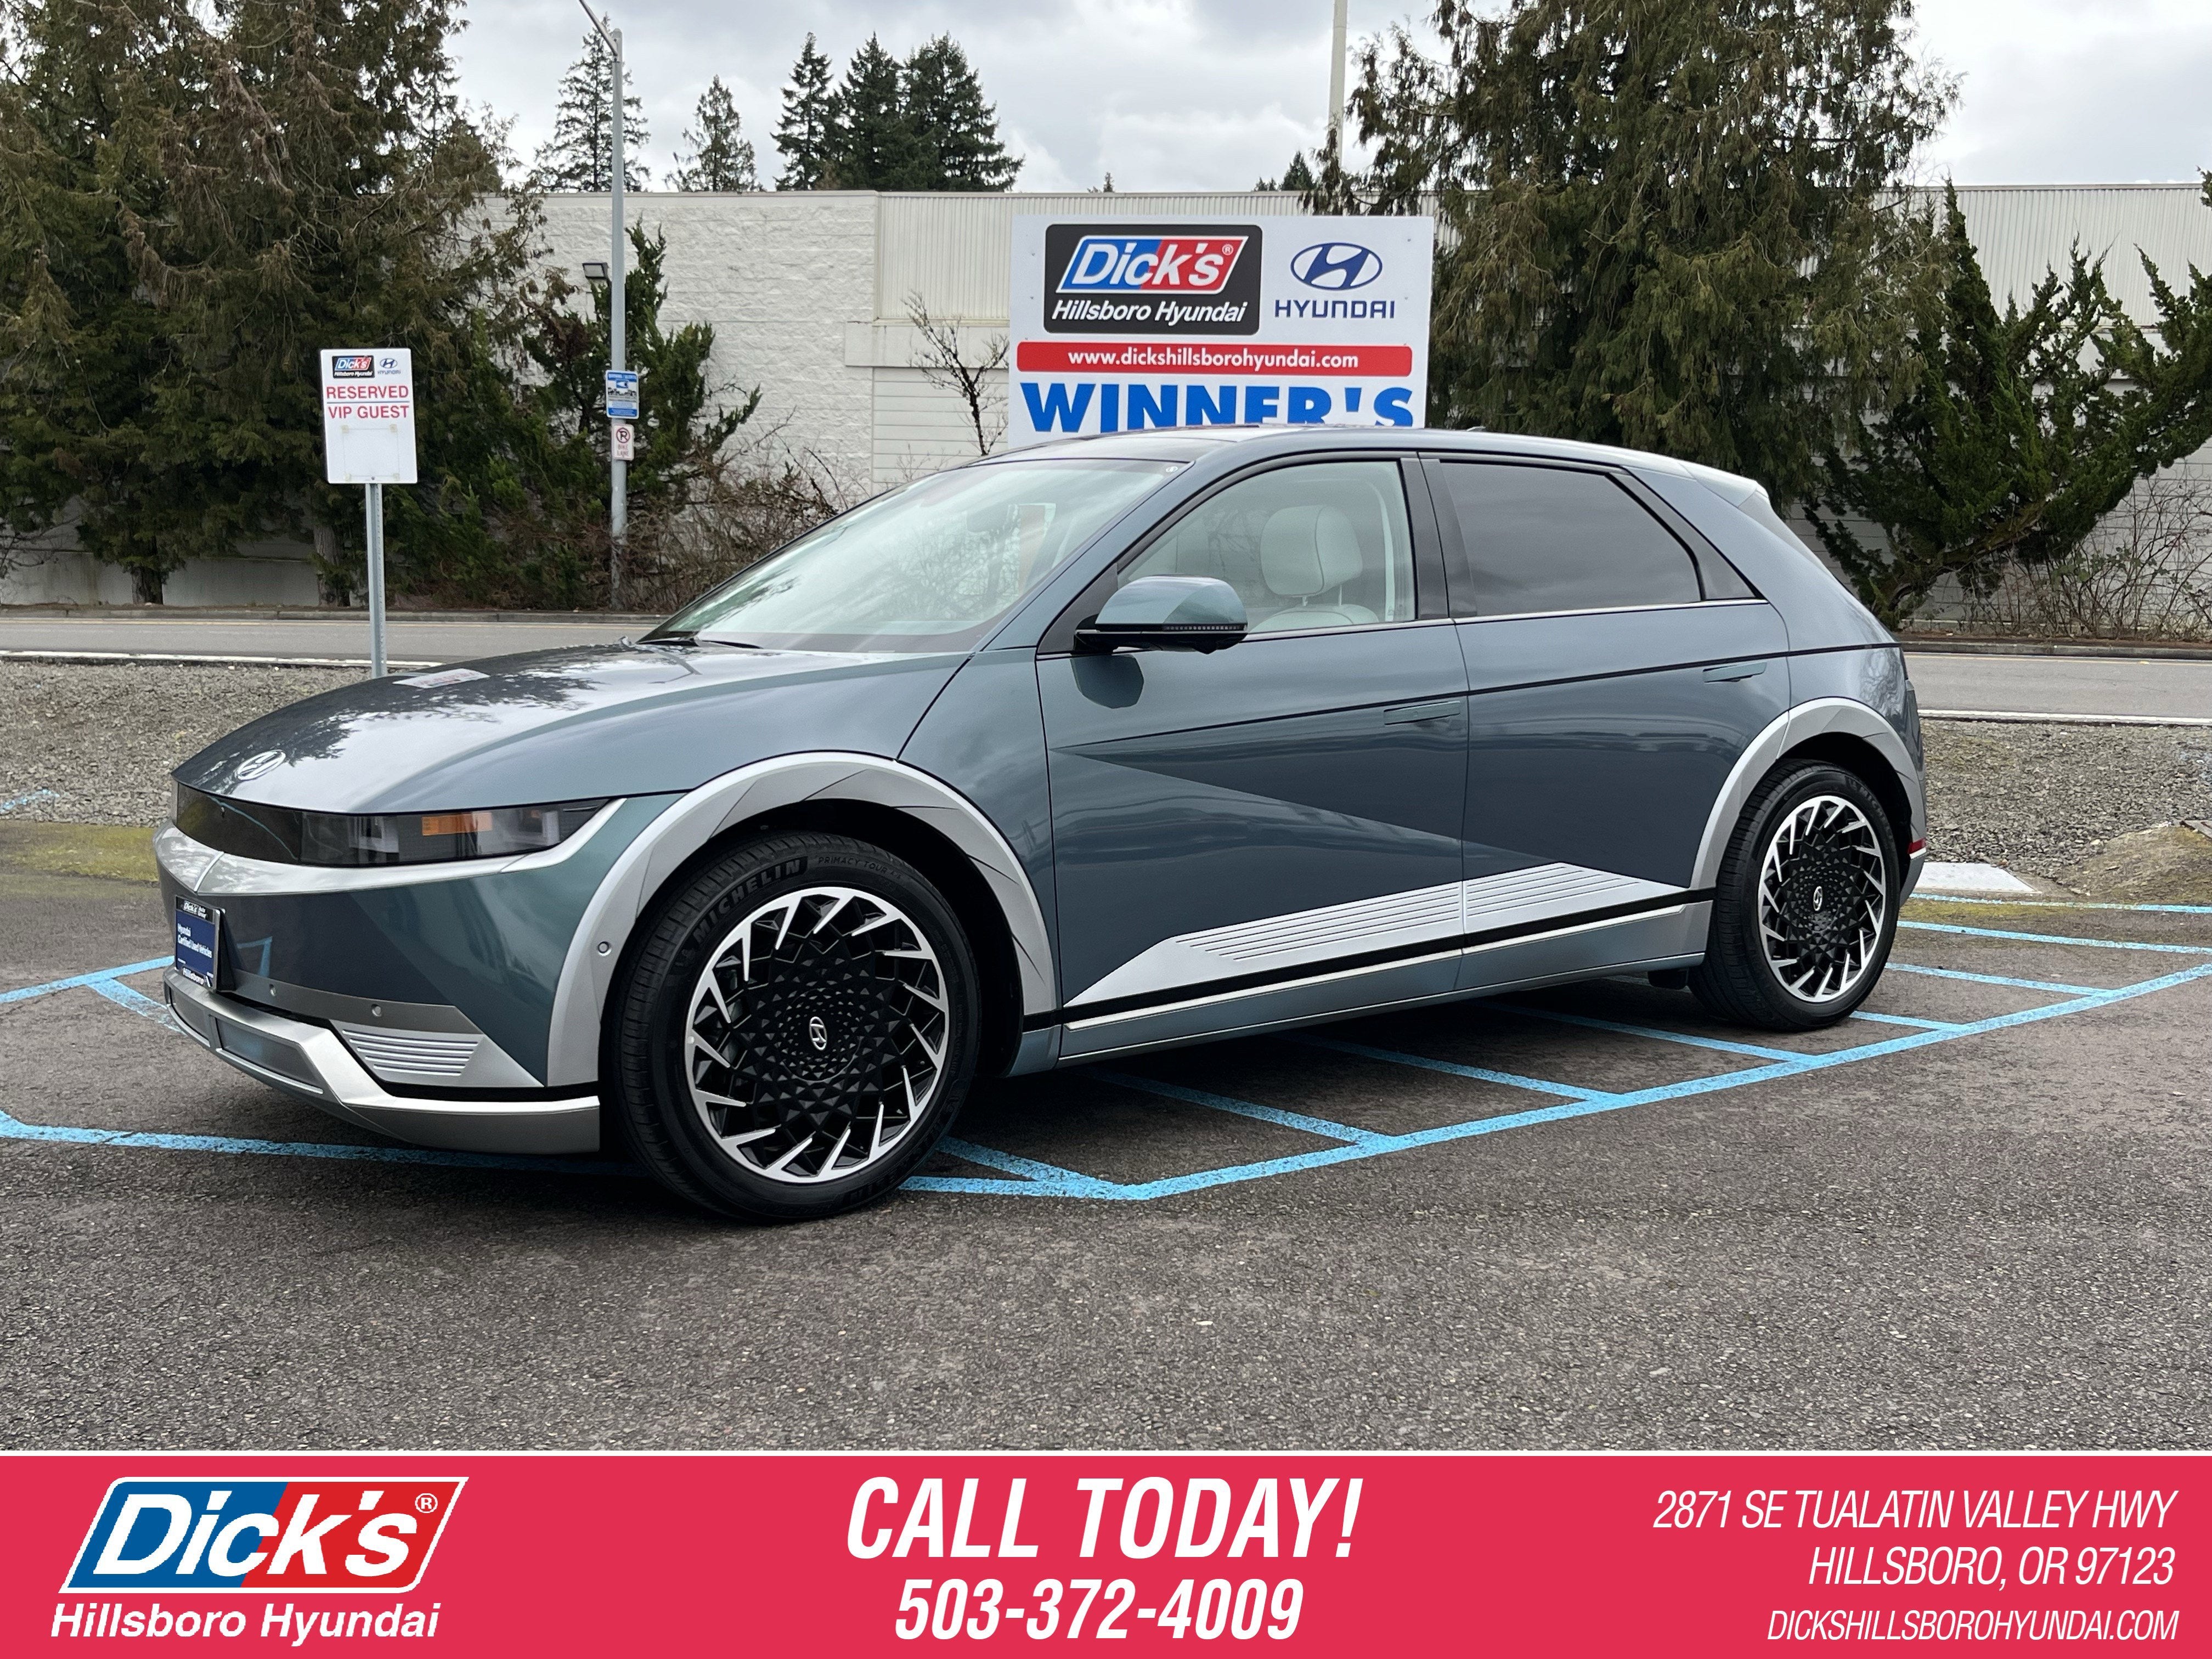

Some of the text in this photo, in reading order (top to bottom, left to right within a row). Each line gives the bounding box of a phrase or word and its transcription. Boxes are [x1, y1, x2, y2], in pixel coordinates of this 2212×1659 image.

[1052, 300, 1248, 326] Hillsboro Hyundai
[1274, 300, 1395, 319] HYUNDAI
[1068, 347, 1359, 372] www.dickshillsborohyundai.com
[326, 385, 409, 399] RESERVED
[328, 405, 409, 419] VIP GUEST
[692, 859, 801, 945] MICHELIN
[818, 856, 860, 865] PRIMACY
[864, 861, 889, 873] TOUR
